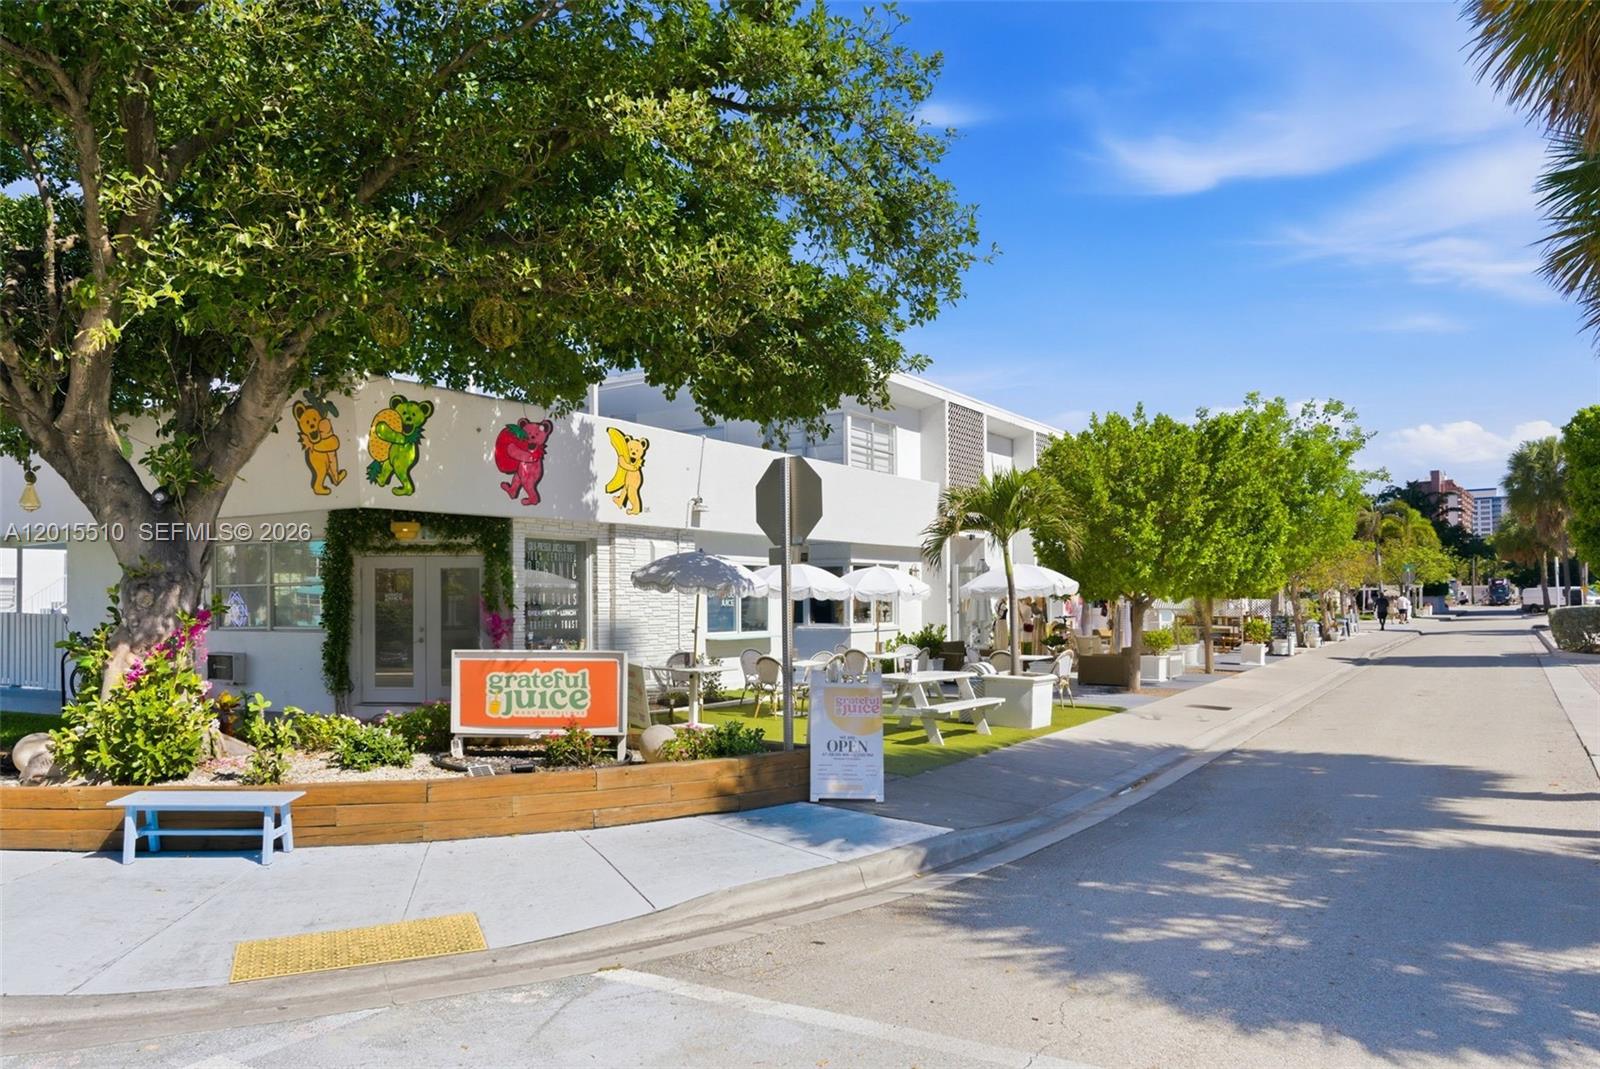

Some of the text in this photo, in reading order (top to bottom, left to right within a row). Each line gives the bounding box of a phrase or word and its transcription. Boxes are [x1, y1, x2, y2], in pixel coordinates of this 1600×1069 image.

[560, 609, 577, 617] LUNCH
[488, 671, 588, 694] grateful
[502, 688, 588, 716] juice
[837, 697, 880, 706] grateful
[842, 704, 880, 714] juice
[826, 740, 868, 752] OPEN
